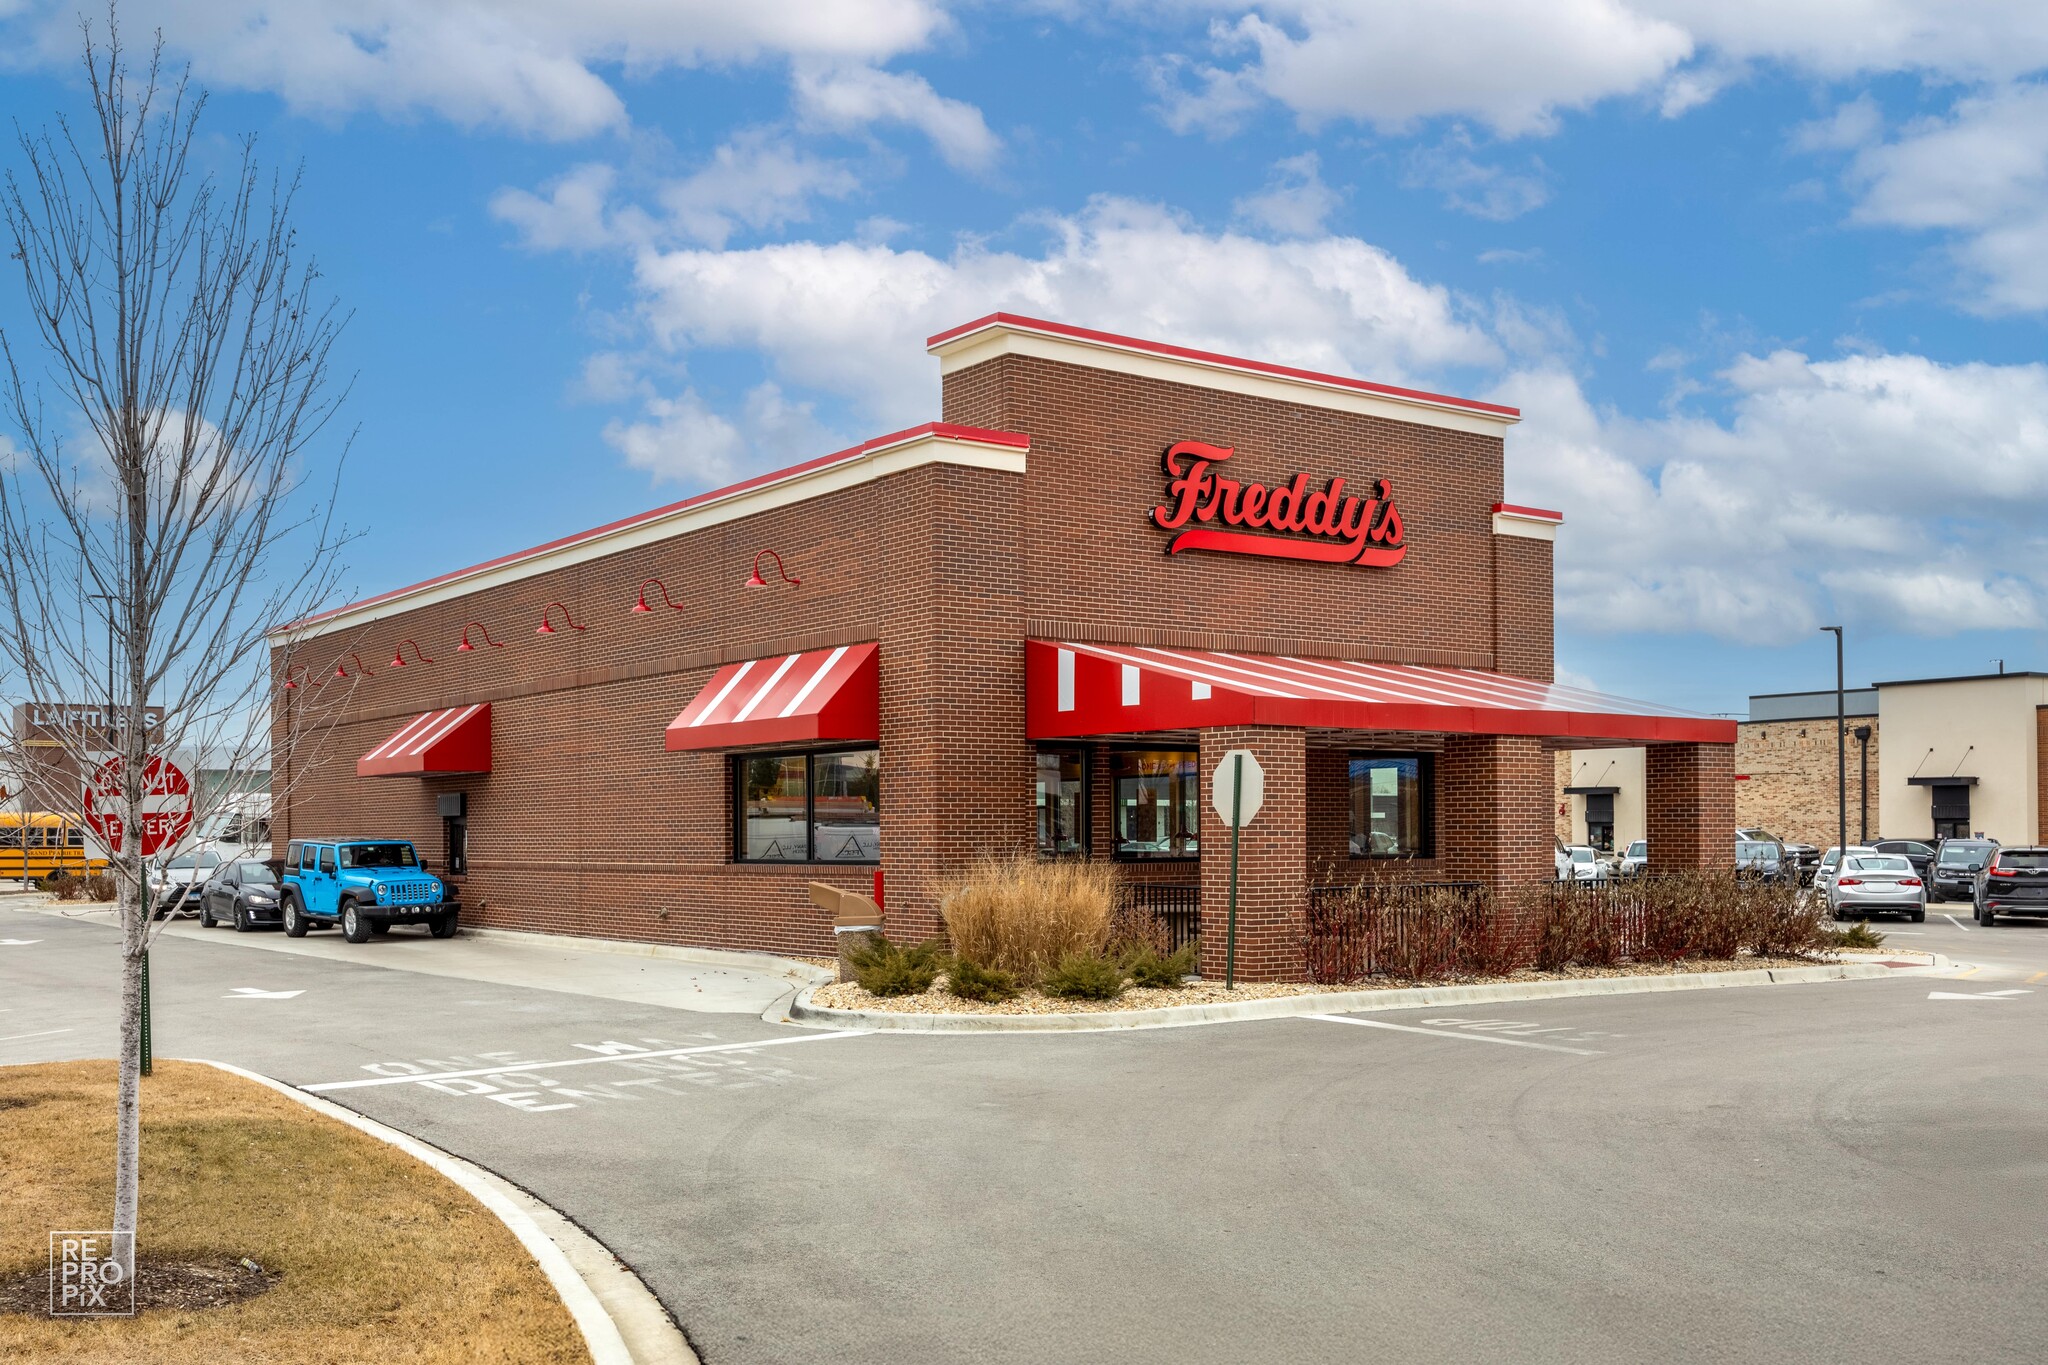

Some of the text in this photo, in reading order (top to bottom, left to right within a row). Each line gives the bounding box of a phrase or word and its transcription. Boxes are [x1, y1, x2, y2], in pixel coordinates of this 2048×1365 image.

[1150, 440, 1408, 567] Freddy's
[67, 710, 158, 730] FITES
[110, 819, 174, 836] EER
[360, 1051, 550, 1077] ONE
[416, 1048, 792, 1096] DO NOT
[485, 1066, 816, 1112] ENTER
